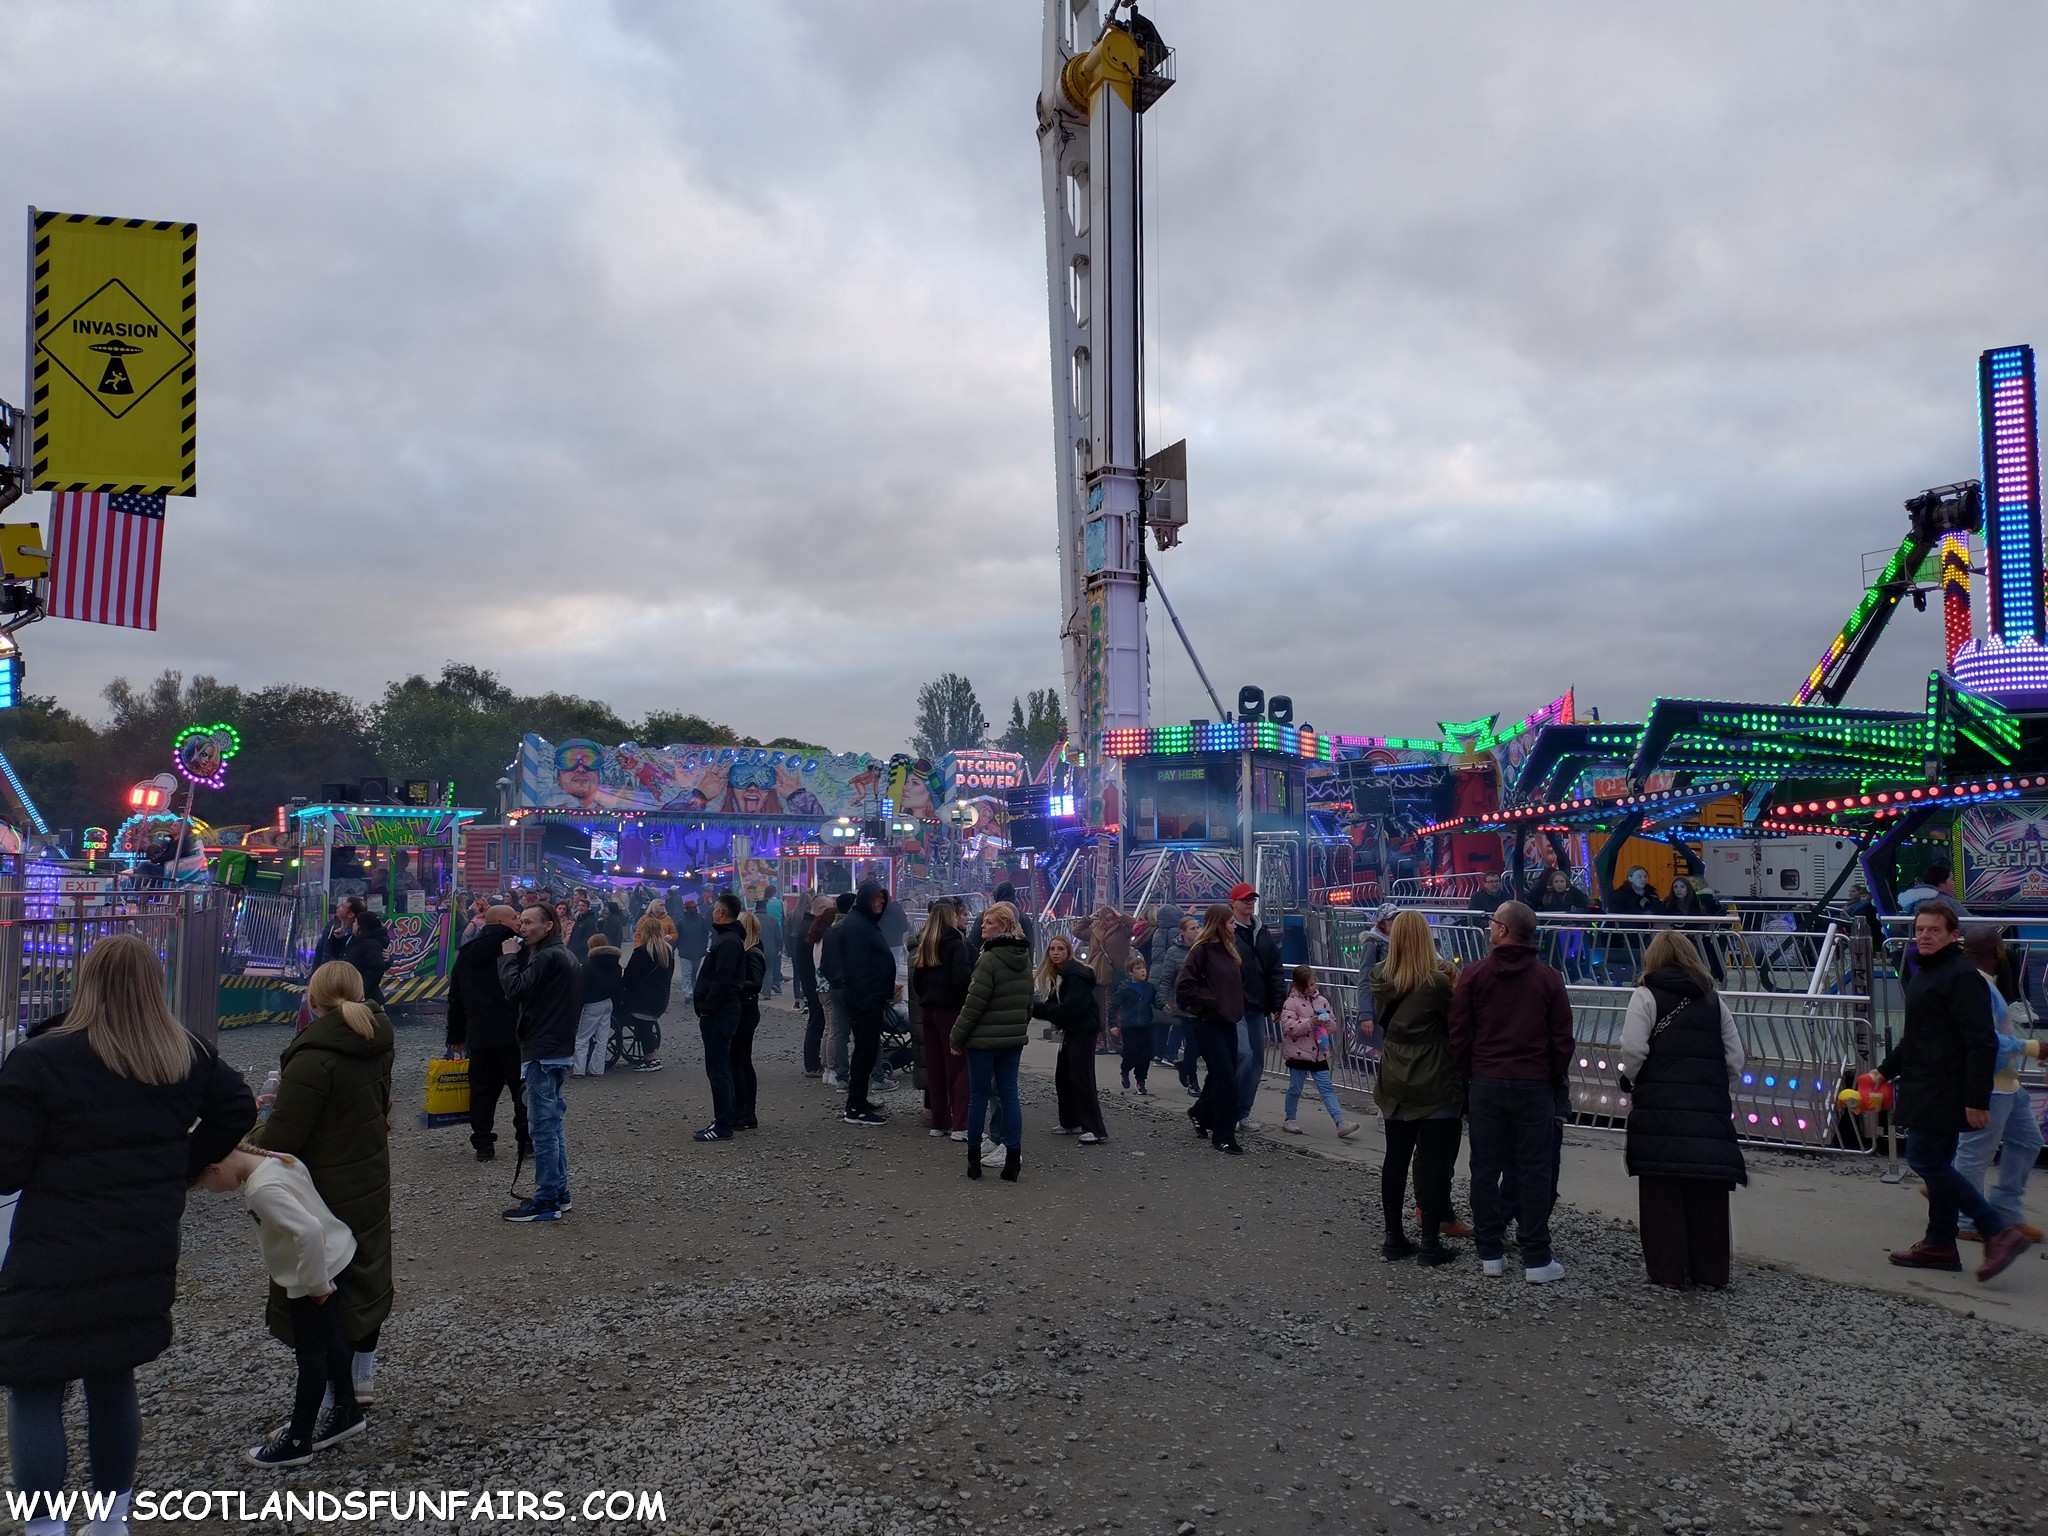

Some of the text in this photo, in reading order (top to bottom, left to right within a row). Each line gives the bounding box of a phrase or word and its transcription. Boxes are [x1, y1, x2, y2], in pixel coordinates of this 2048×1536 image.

[73, 319, 159, 338] INVASION
[681, 747, 820, 775] SUPERBOD
[956, 759, 1017, 774] TECHNO
[955, 774, 1016, 789] POWER
[1157, 769, 1205, 780] PAY HERE
[83, 841, 108, 849] PSYCHO
[1990, 840, 2048, 853] SUPE
[1968, 852, 2048, 867] TROO
[65, 881, 100, 892] EXIT
[393, 915, 422, 938] SO
